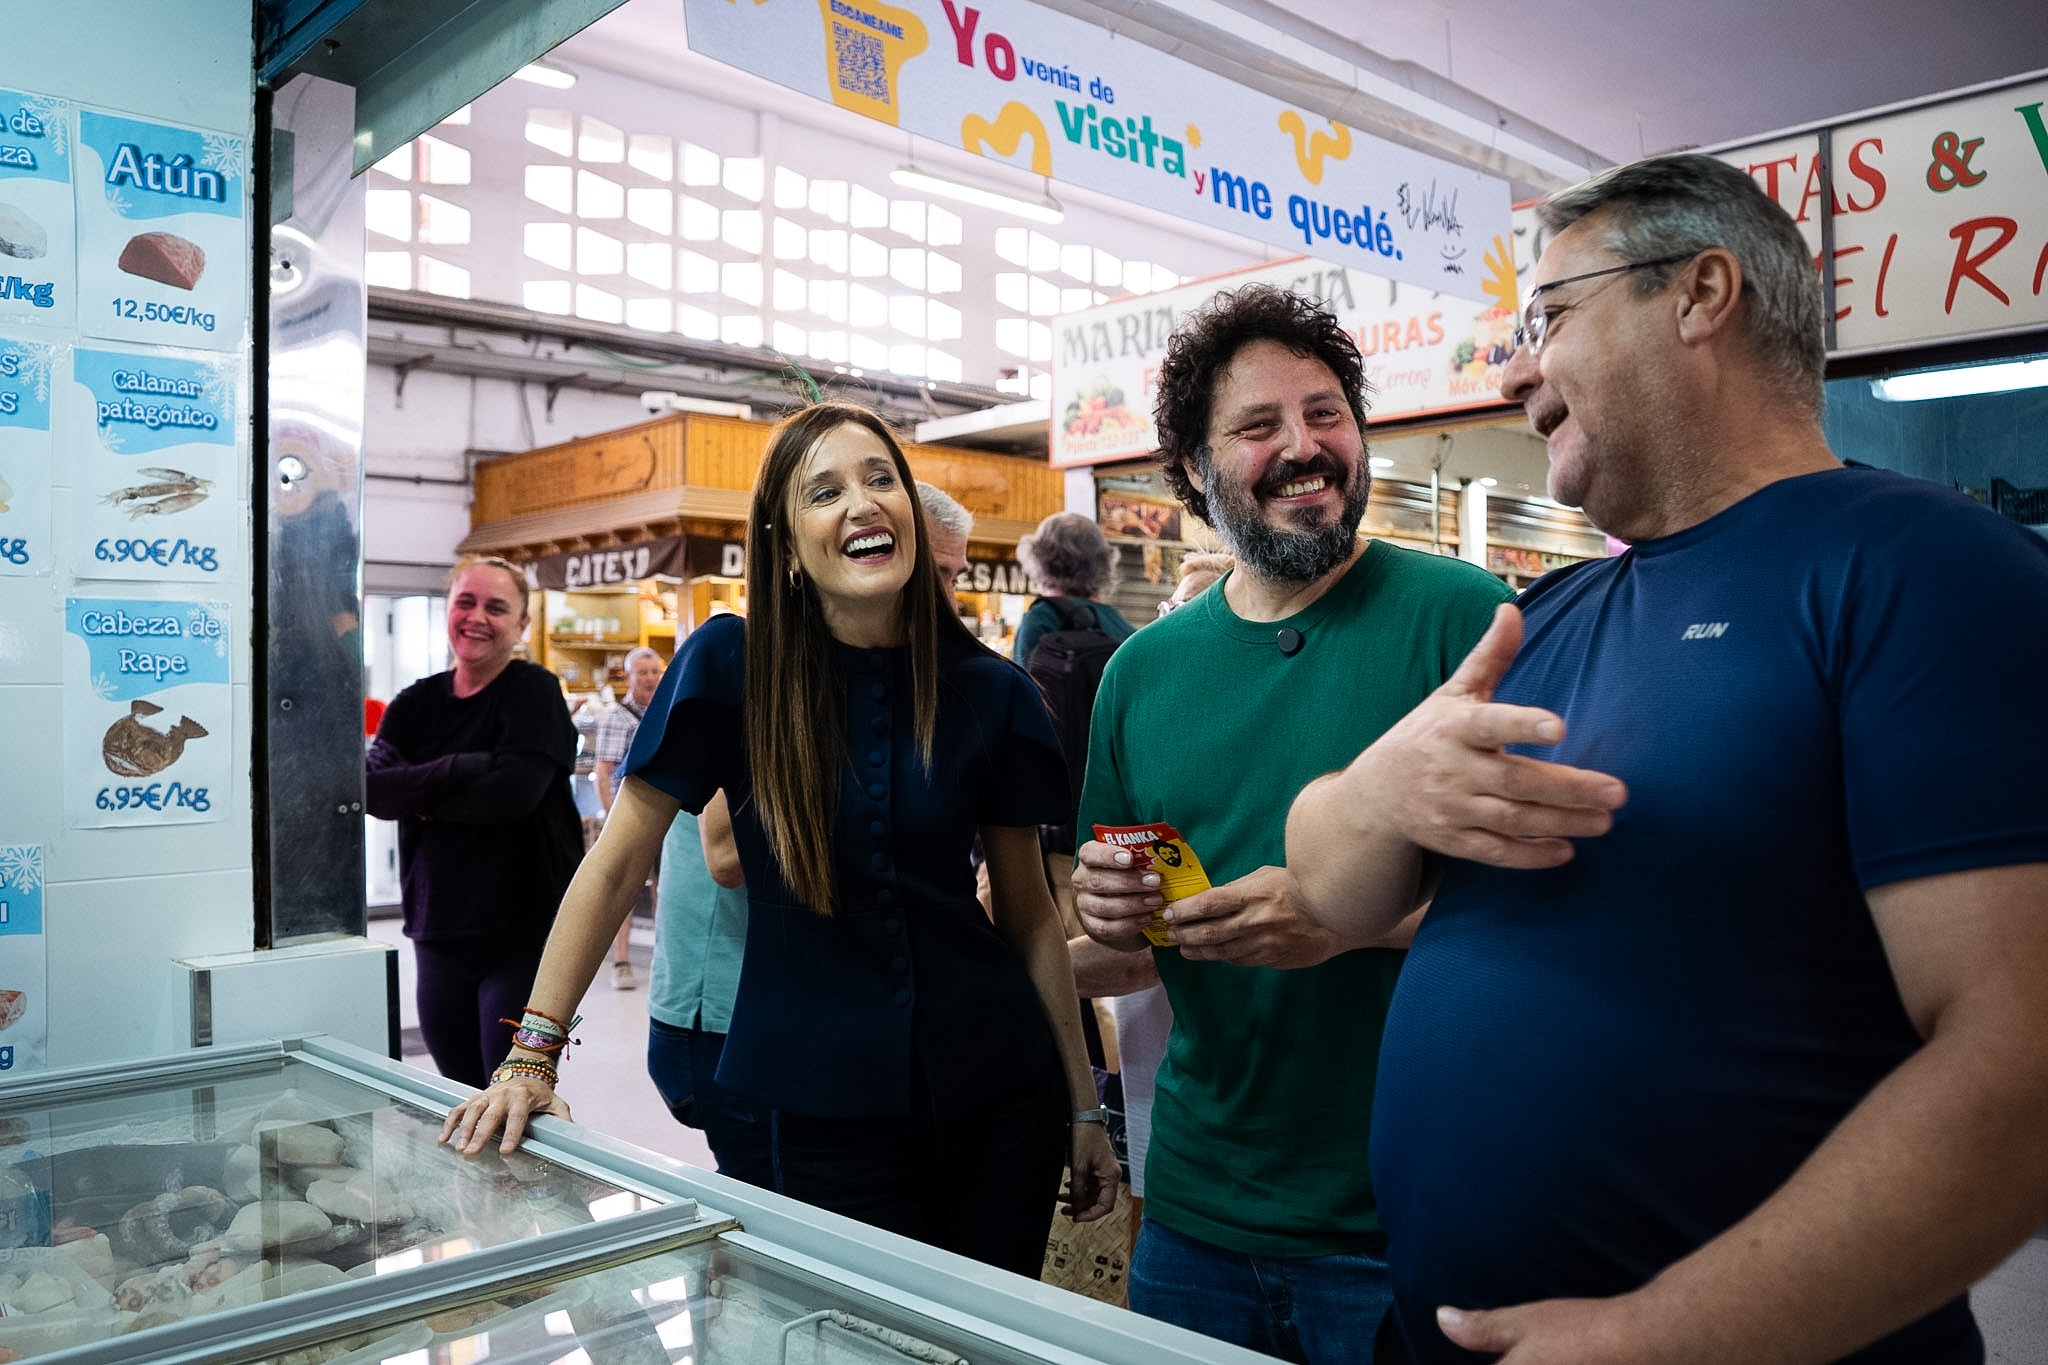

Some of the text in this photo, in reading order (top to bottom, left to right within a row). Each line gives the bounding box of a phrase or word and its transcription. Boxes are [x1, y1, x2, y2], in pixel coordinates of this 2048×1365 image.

[938, 0, 1114, 104] Yo venía de
[9, 108, 44, 137] de
[106, 142, 226, 202] Atún
[1926, 131, 1988, 193] &
[1193, 169, 1206, 195] y
[1211, 166, 1272, 220] me
[1288, 194, 1403, 261] quedé.
[112, 298, 216, 331] 12,50€/kg
[112, 370, 202, 398] Calamar
[97, 400, 217, 431] patagónico
[95, 538, 219, 572] 6,90€/kg
[81, 611, 221, 637] Cabeza de
[1681, 622, 1730, 641] RUN
[119, 649, 188, 682] Rape
[95, 782, 211, 812] 6,95€/kg
[1115, 830, 1160, 846] KANKA
